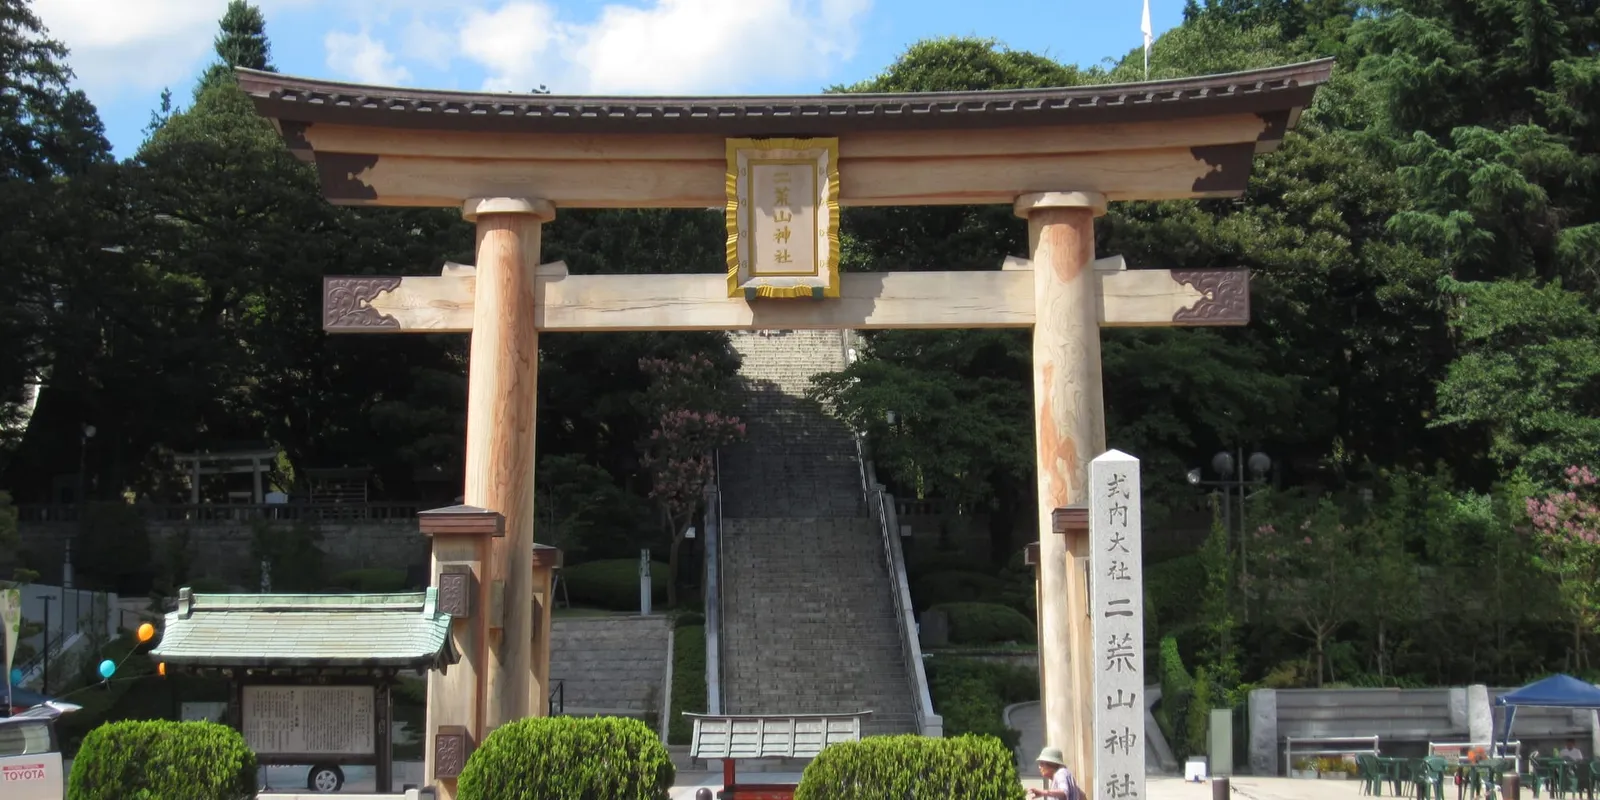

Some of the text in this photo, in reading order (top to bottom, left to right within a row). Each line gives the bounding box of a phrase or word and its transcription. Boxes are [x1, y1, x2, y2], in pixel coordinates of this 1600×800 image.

[773, 171, 793, 264] 二荒山神社
[1104, 598, 1137, 799] 二荒山神社
[3, 769, 45, 781] TOYOTA
